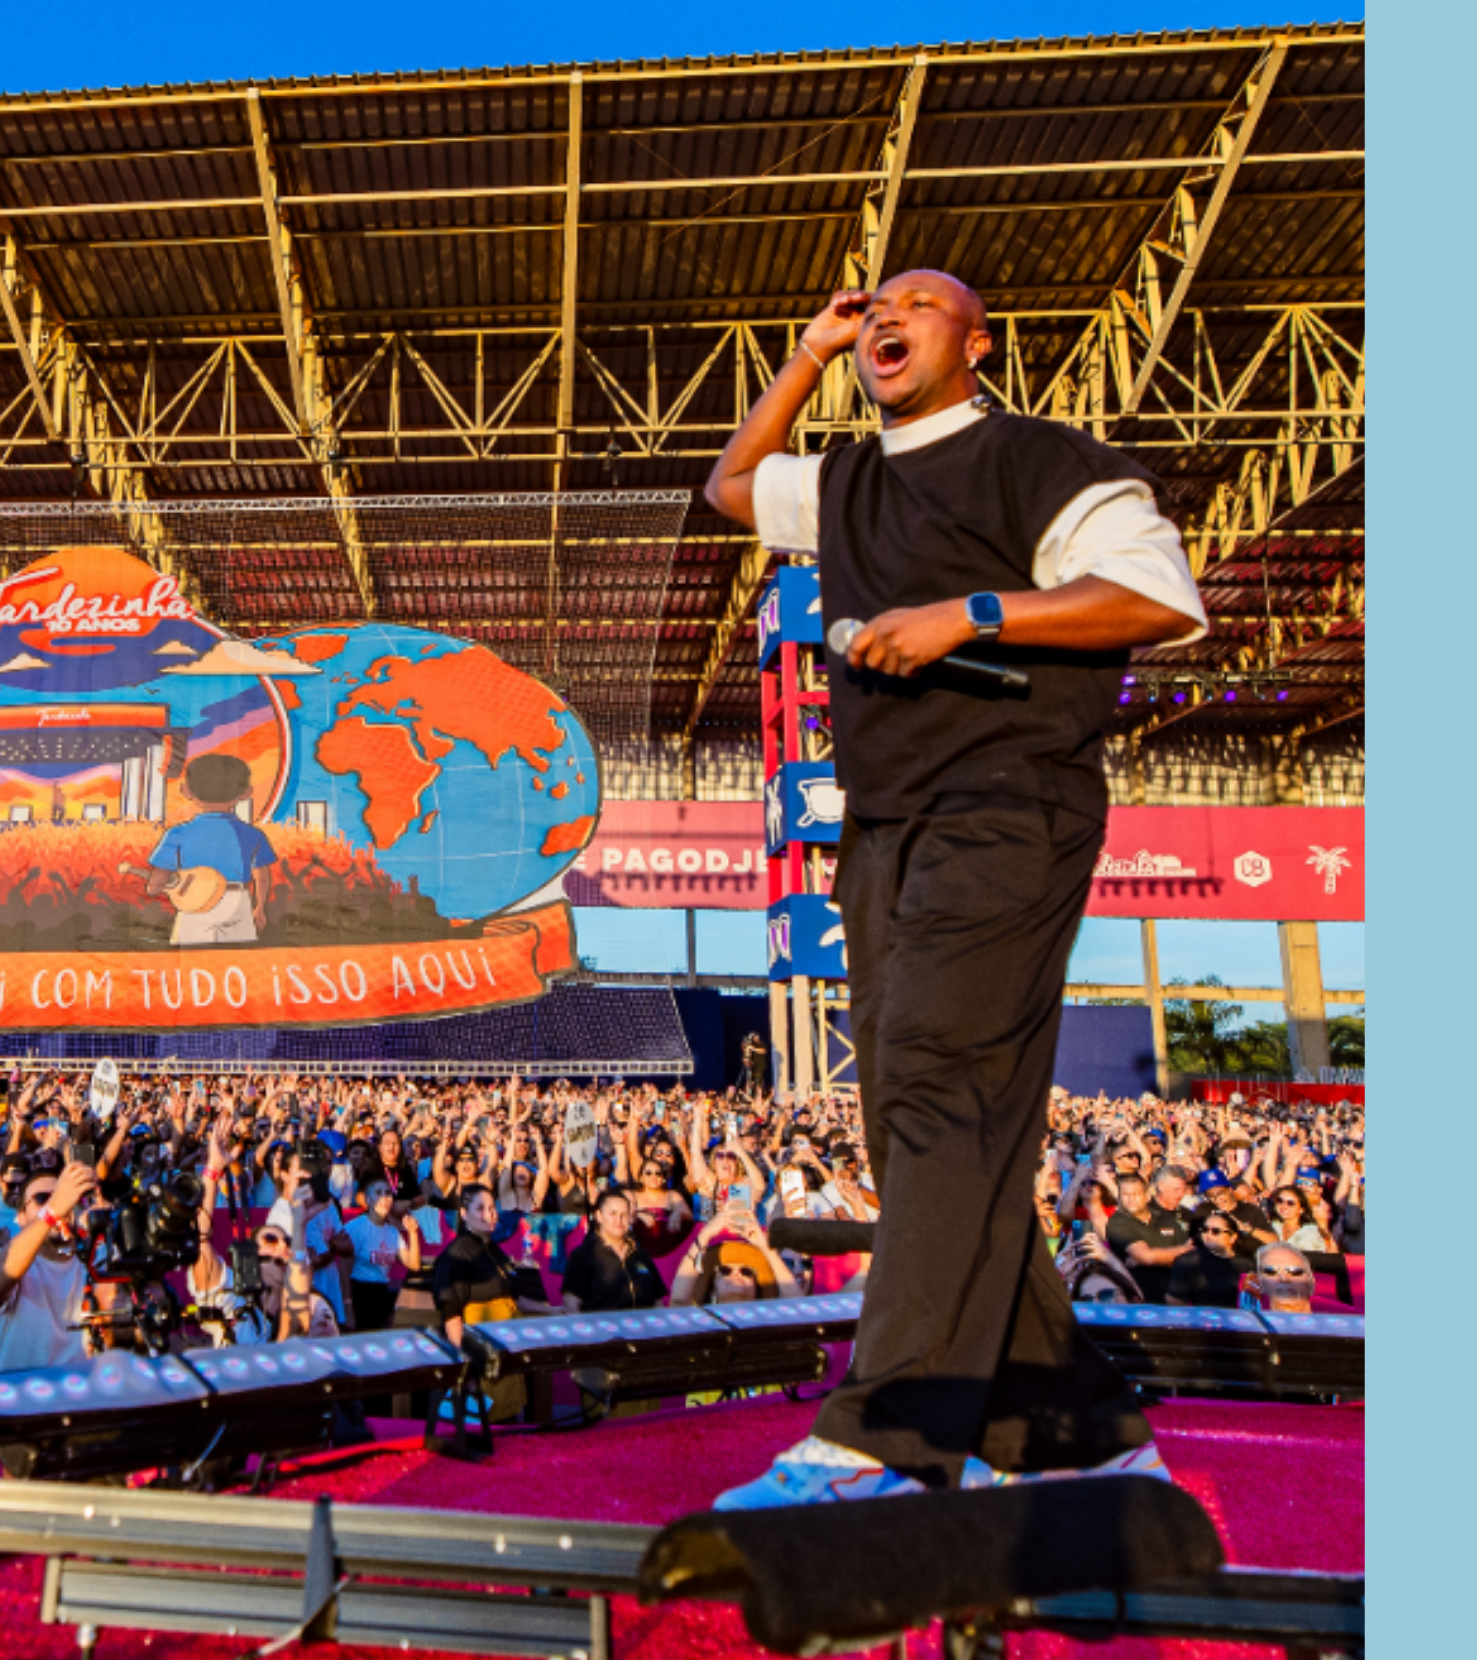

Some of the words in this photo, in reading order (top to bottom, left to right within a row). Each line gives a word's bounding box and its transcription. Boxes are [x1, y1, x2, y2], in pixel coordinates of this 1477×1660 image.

[46, 619, 71, 633] 10
[76, 617, 140, 632] ANOS
[30, 967, 113, 1010] COM
[131, 965, 248, 1010] TUDO
